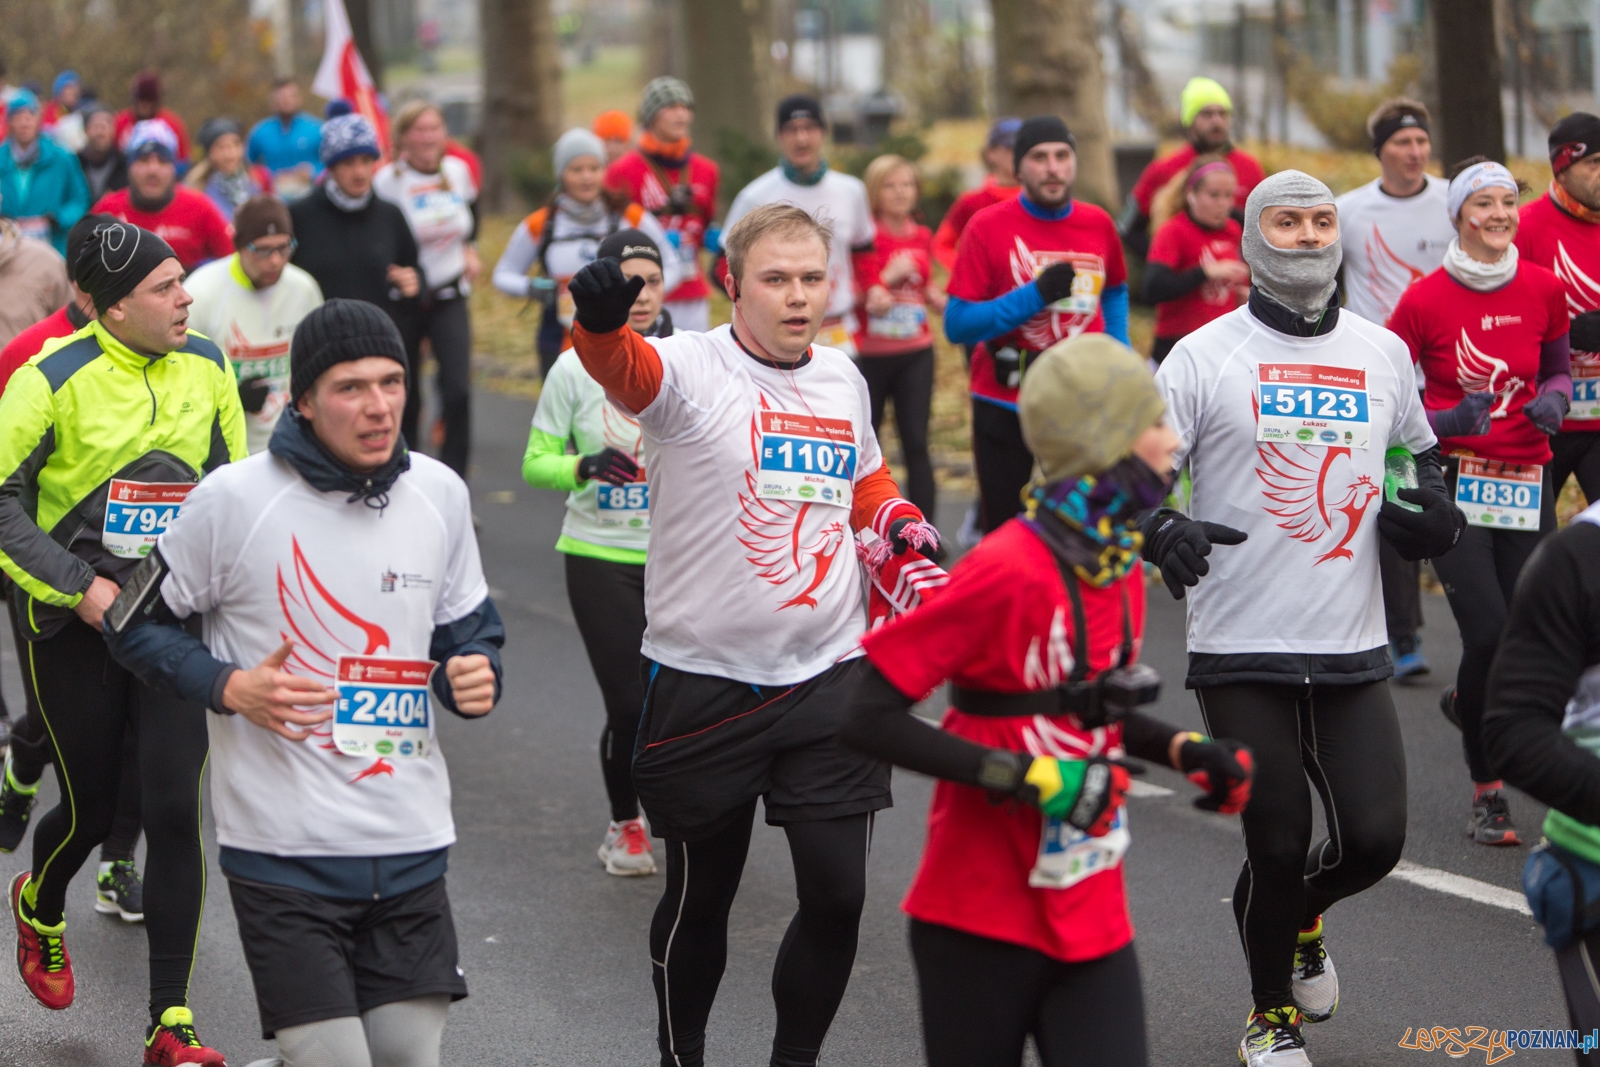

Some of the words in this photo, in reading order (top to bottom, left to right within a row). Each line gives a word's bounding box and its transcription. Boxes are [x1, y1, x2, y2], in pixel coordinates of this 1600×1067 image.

[1318, 373, 1360, 385] RunPoland.org
[1263, 394, 1272, 404] E
[1275, 388, 1358, 418] 5123
[764, 447, 773, 459] E
[778, 440, 850, 475] 1107
[1468, 480, 1531, 508] 1830
[109, 513, 118, 523] E
[121, 507, 180, 533] 794
[339, 698, 349, 712] E
[351, 690, 425, 725] 2404
